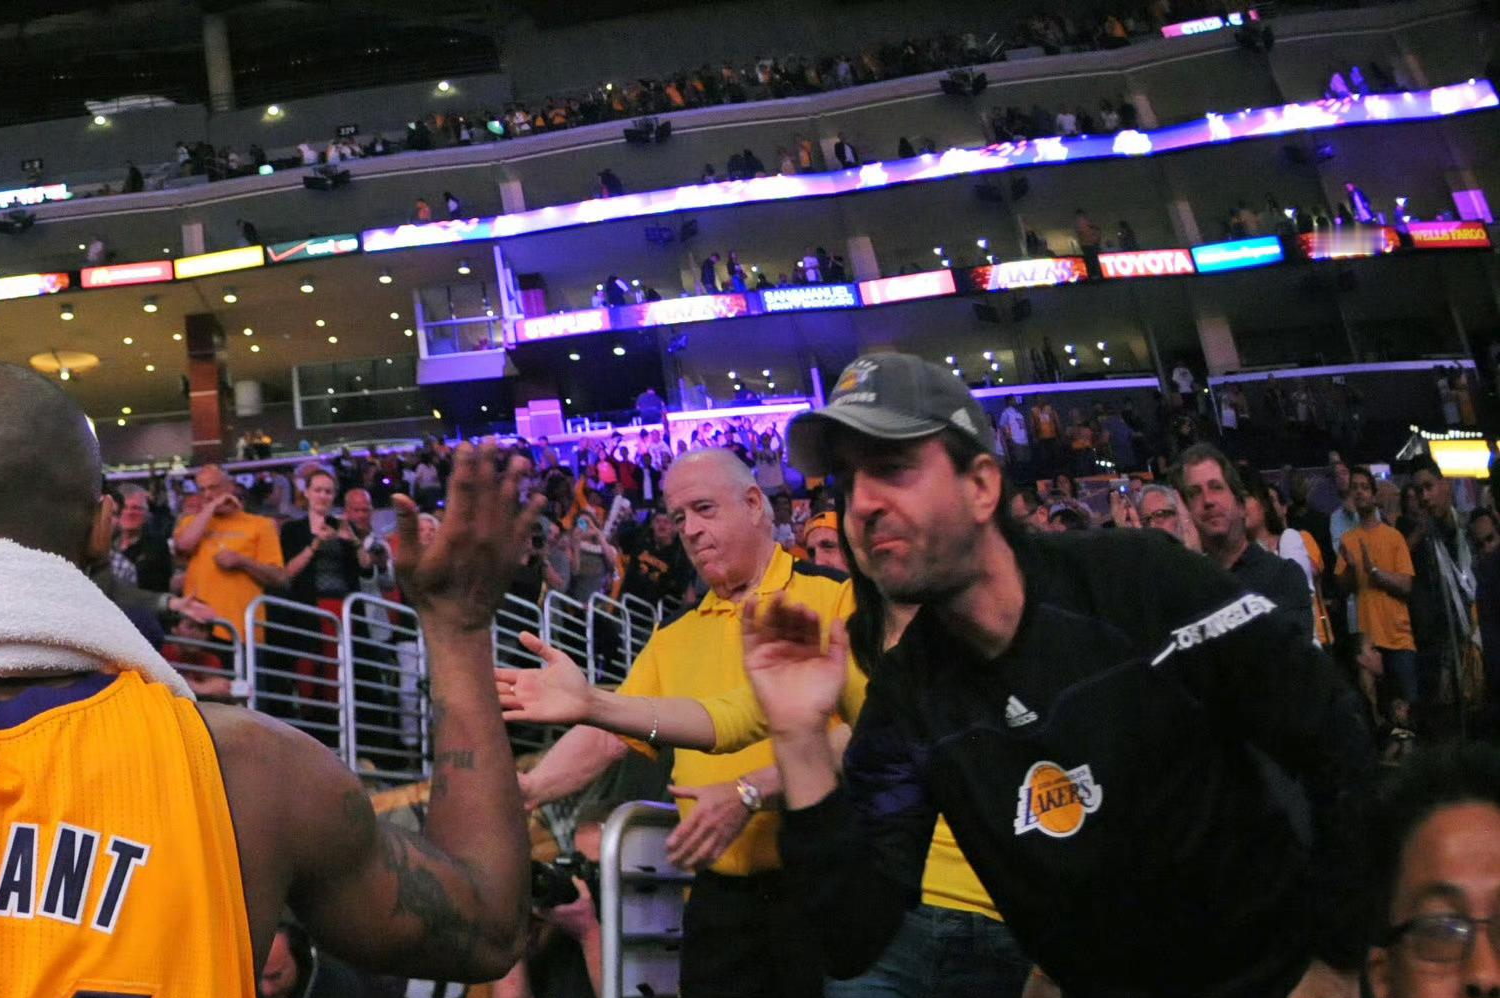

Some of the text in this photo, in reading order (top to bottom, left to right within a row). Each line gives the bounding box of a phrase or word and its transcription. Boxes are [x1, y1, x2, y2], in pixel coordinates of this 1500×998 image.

[1411, 229, 1451, 242] WELLS
[1099, 251, 1192, 275] TOYOTA
[1022, 778, 1095, 828] LAKERS
